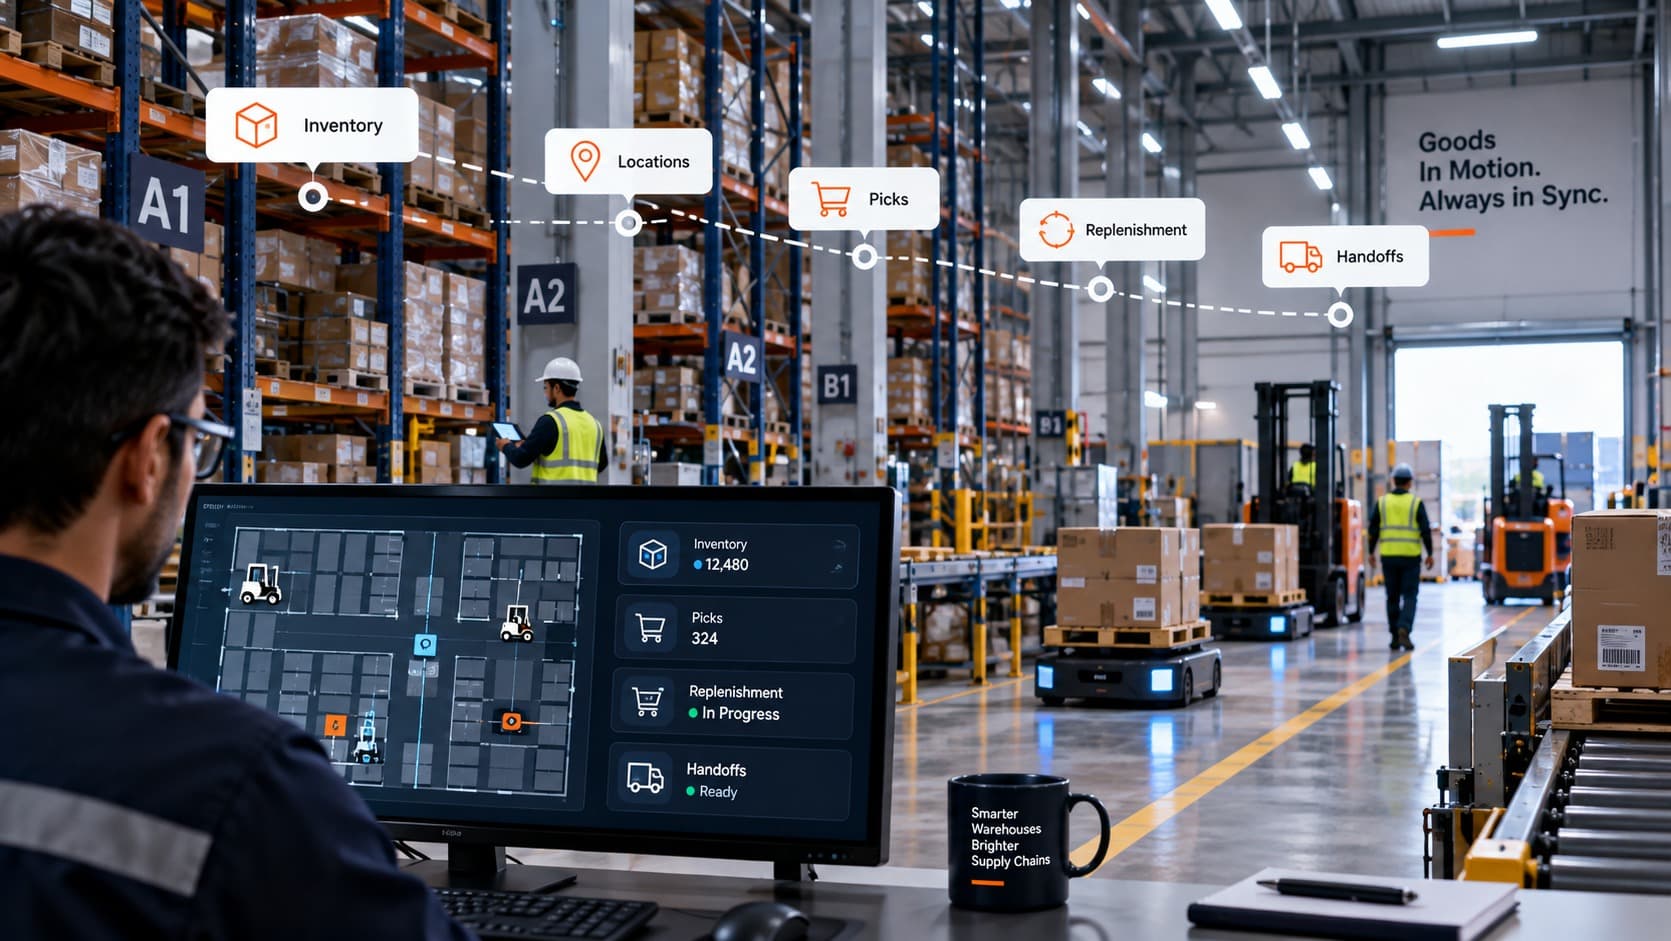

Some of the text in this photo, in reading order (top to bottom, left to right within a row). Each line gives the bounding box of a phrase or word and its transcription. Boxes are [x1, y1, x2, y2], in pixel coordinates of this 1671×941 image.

[1418, 128, 1497, 154] Goods
[1420, 156, 1542, 182] In Motion.
[137, 176, 190, 234] A1
[1419, 184, 1610, 214] Always in Sync.
[522, 276, 566, 314] A2
[726, 341, 757, 375] A2
[823, 373, 851, 399] B1
[694, 538, 748, 553] Inventory
[705, 557, 749, 574] 12,480
[692, 611, 723, 624] Picks
[691, 631, 719, 645] 324
[689, 684, 784, 701] Replenishment
[702, 705, 780, 724] In Progress
[686, 762, 747, 777] Handoffs
[699, 784, 738, 801] Ready
[971, 806, 1019, 820] Smarter
[971, 822, 1042, 835] Warehouses
[971, 838, 1019, 854] Brighter
[971, 854, 1051, 870] Supply Chains
